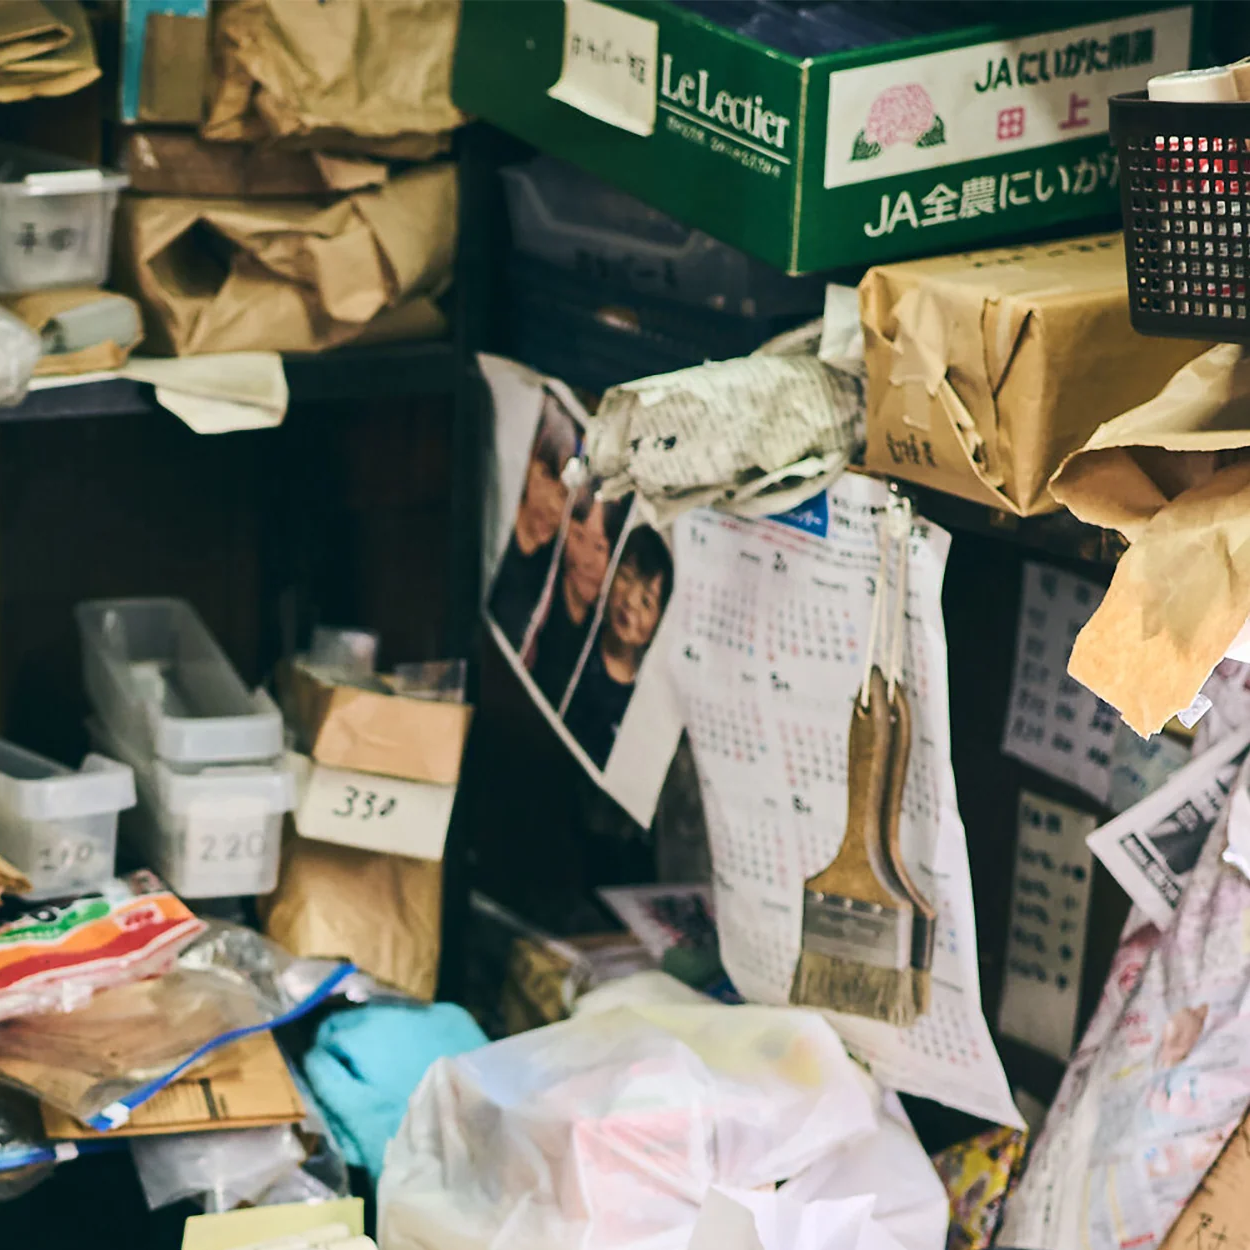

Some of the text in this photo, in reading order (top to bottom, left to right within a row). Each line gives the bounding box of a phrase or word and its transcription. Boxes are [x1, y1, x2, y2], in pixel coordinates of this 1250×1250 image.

[661, 53, 696, 107] Le
[697, 69, 790, 148] Lectier
[864, 153, 1121, 238] JA全農にいが
